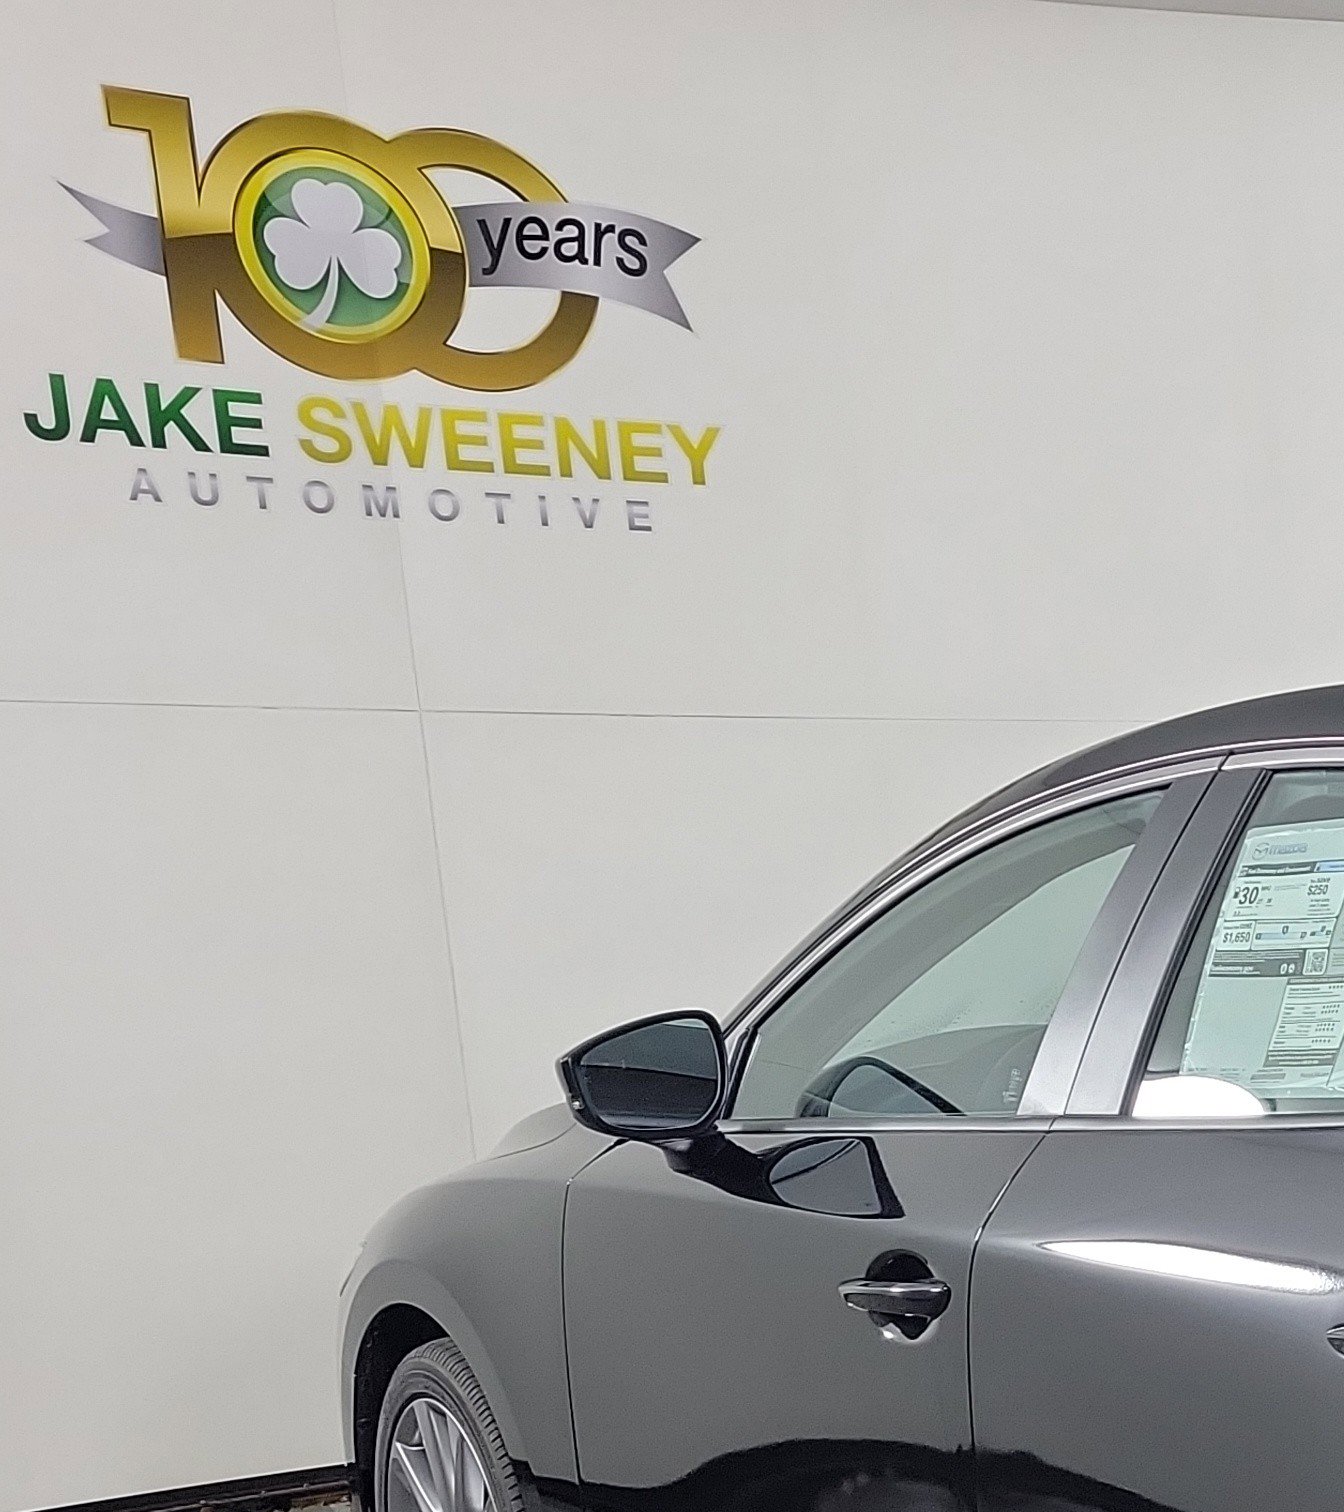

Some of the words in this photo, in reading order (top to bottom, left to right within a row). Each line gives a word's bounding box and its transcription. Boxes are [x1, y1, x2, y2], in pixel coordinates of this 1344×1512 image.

[477, 213, 648, 277] years
[23, 373, 271, 458] JAKE
[297, 395, 722, 486] SWEENEY
[129, 467, 653, 533] AUTOMOTIVE
[1239, 886, 1259, 905] 30
[1307, 884, 1328, 896] $250
[1222, 932, 1251, 943] $1,650
